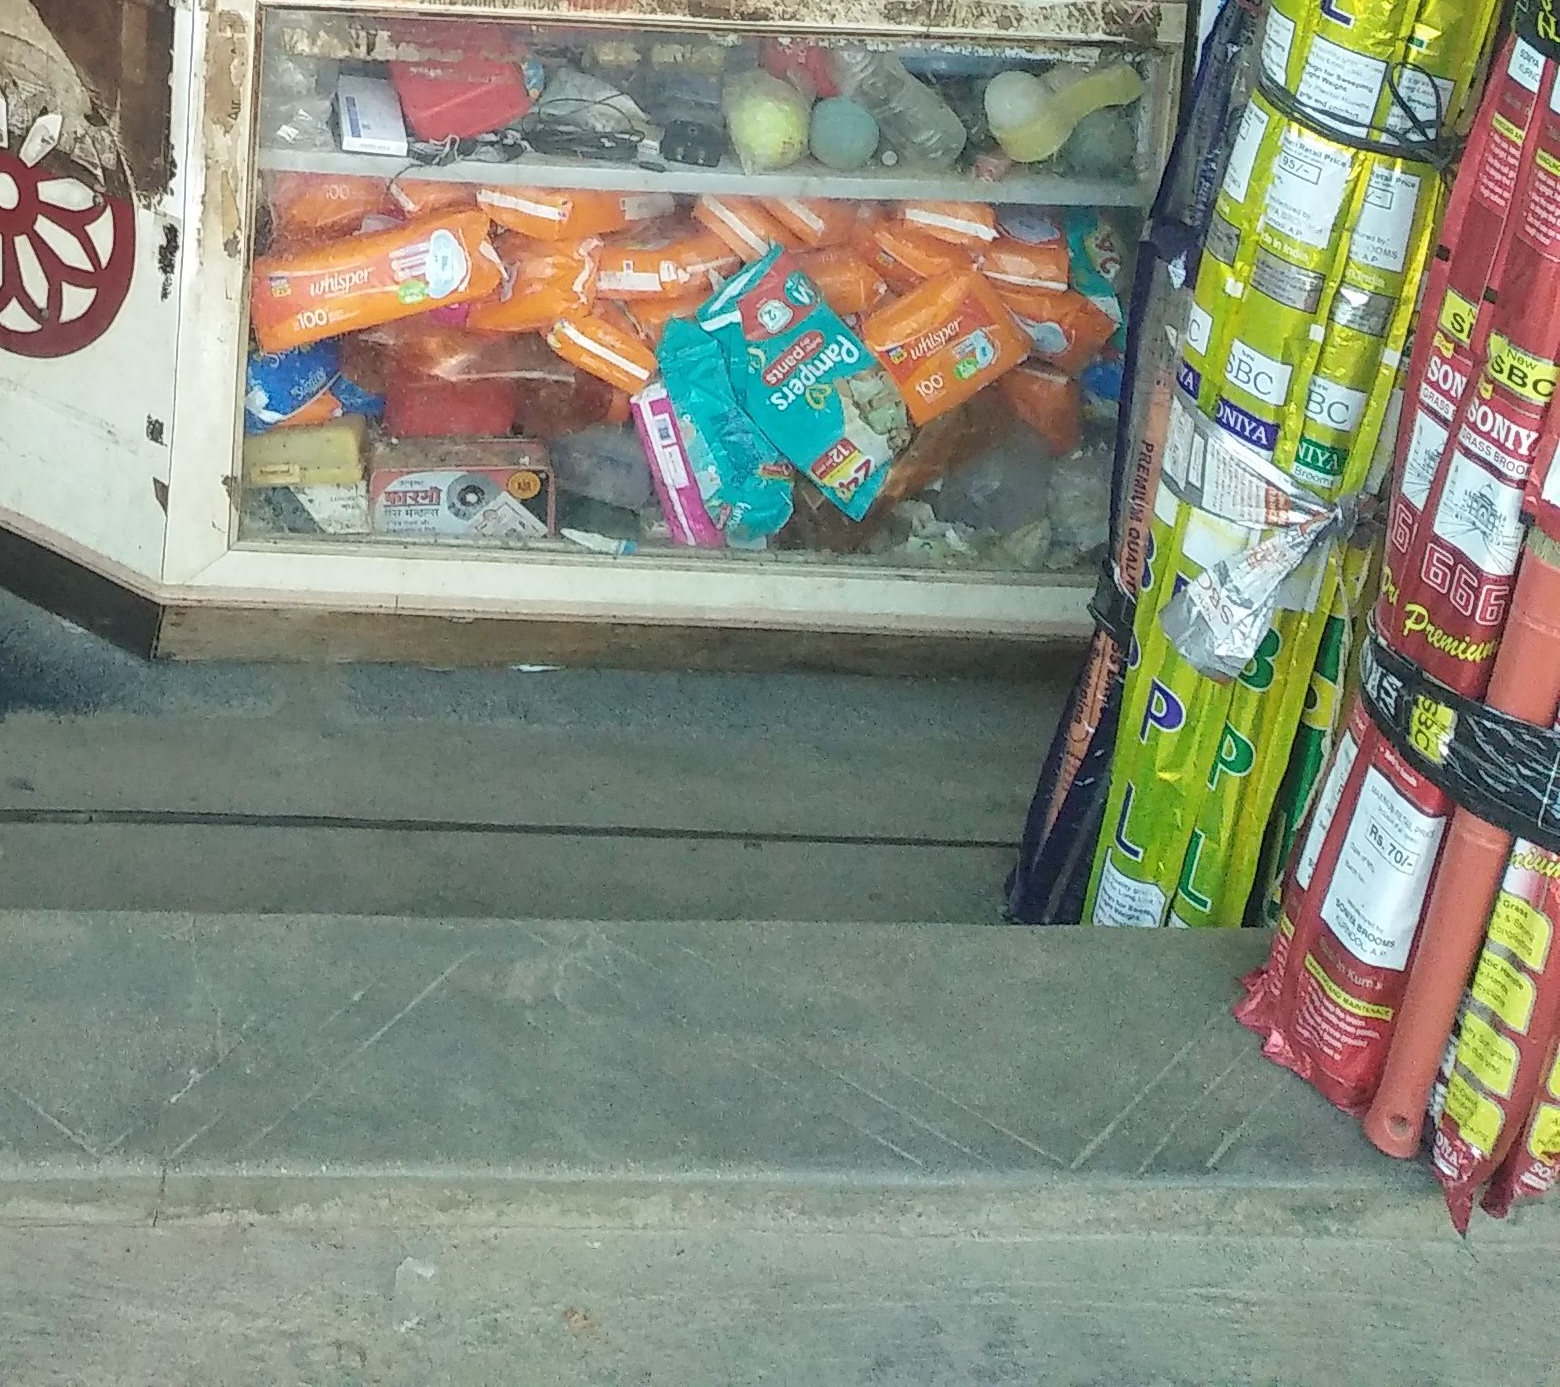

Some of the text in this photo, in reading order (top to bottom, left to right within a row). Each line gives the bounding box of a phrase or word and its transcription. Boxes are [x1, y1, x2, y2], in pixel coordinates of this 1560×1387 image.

[1298, 142, 1348, 169] Retail Price
[1395, 174, 1416, 190] Price
[309, 266, 373, 296] whisper
[295, 308, 329, 327] 100
[910, 315, 963, 360] whisper
[764, 345, 806, 386] pants
[771, 334, 860, 411] Pampers
[1490, 352, 1557, 398] SBC
[1506, 348, 1538, 371] New
[915, 373, 944, 397] 100
[1422, 384, 1450, 414] GRASS
[1216, 400, 1269, 446] ONIYA
[1307, 391, 1350, 426] BC
[1465, 394, 1538, 457] SONIY
[1297, 441, 1339, 471] NIYA
[1461, 425, 1530, 480] GRASS BROO
[1132, 441, 1155, 521] PREMIUM
[1124, 523, 1144, 593] QUALIT
[1420, 540, 1511, 627] 666
[1369, 822, 1415, 872] Rs. 70/-
[1356, 922, 1397, 949] BROOMS
